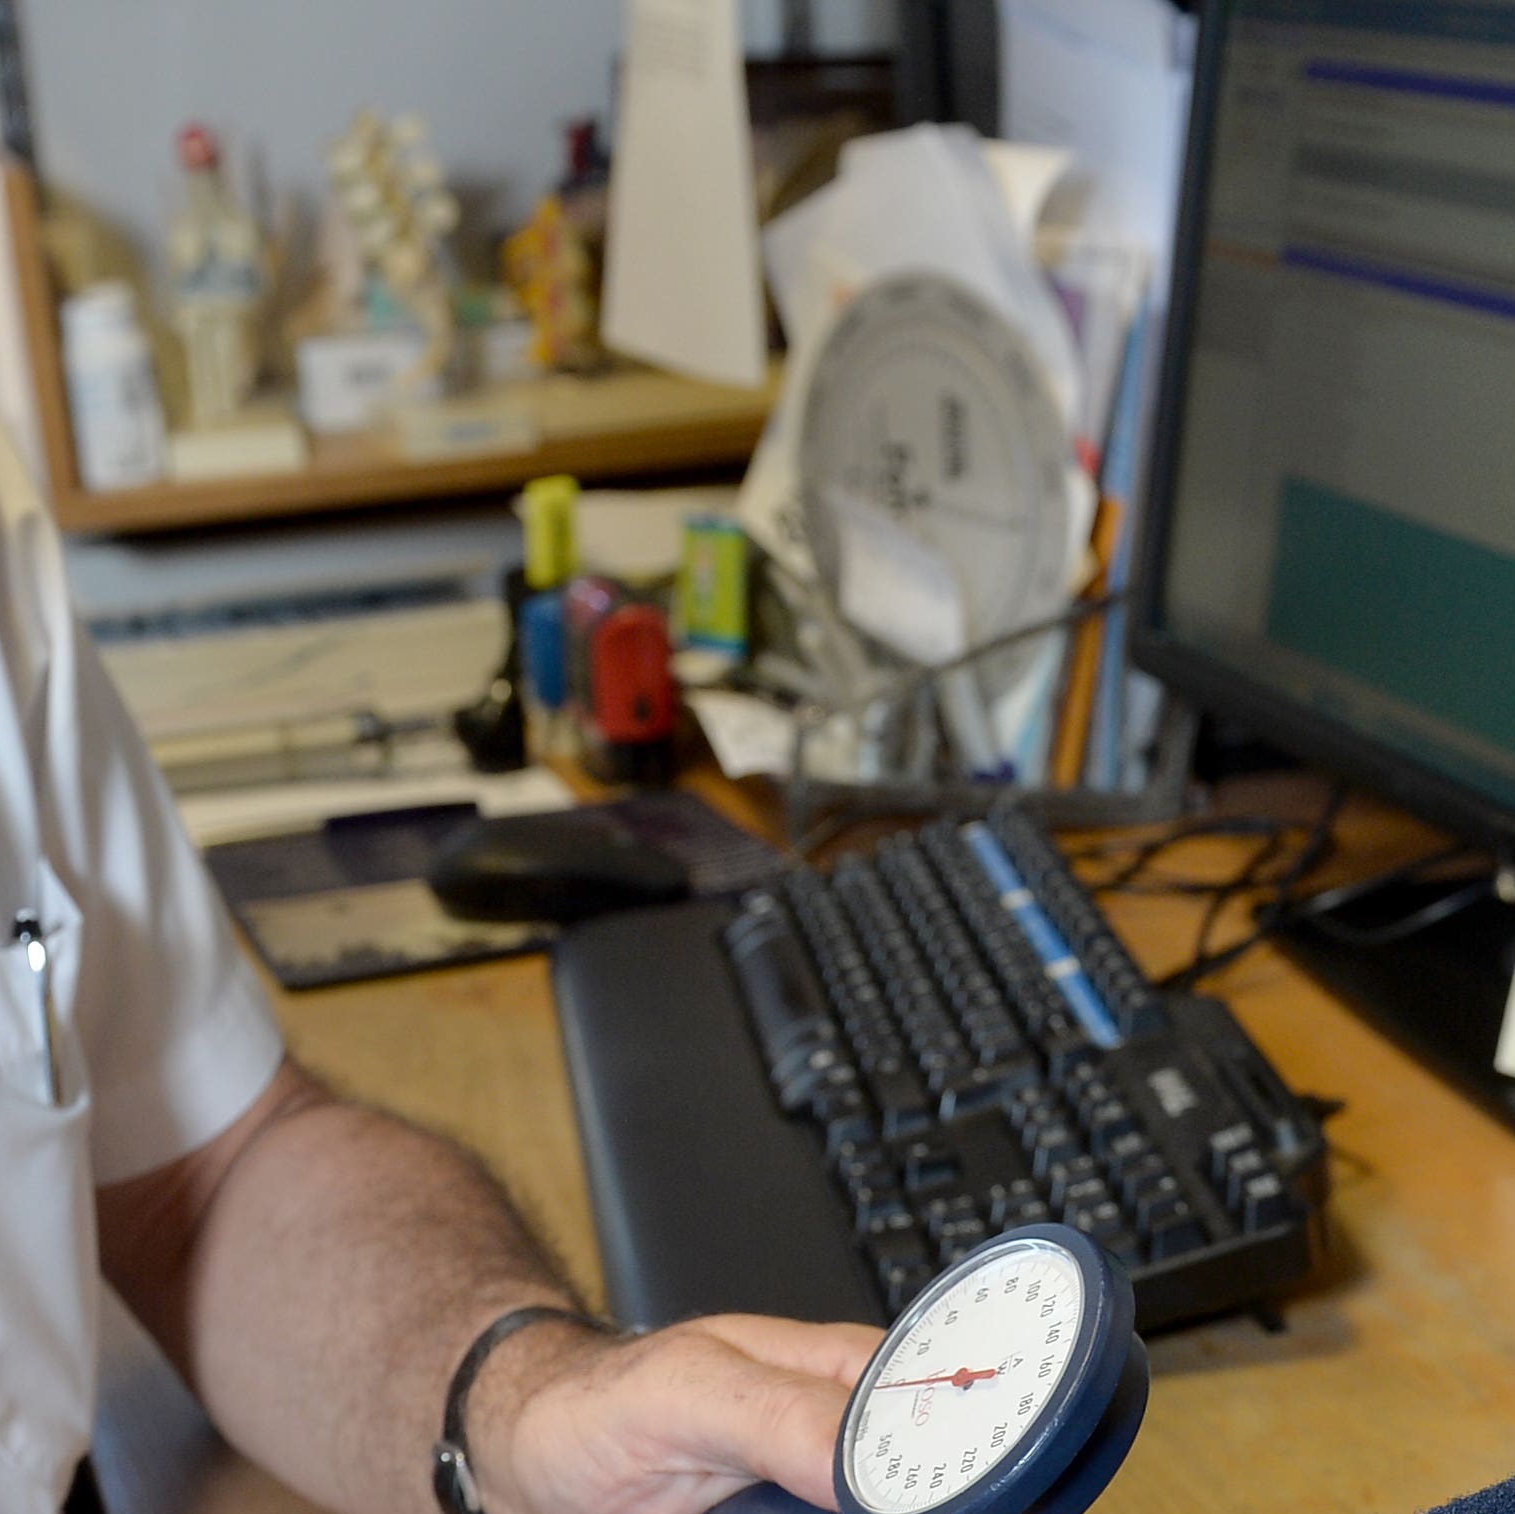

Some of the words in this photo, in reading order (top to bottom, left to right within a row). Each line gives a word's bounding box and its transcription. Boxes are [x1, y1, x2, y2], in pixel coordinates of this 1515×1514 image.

[974, 1287, 990, 1303] 60
[1004, 1276, 1019, 1294] 80
[1025, 1280, 1041, 1302] 100
[944, 1309, 959, 1325] 40
[1040, 1294, 1057, 1318] 120
[1045, 1320, 1062, 1344] 140
[917, 1338, 932, 1356] 20
[1038, 1354, 1055, 1379] 160
[1017, 1392, 1034, 1416] 180
[875, 1433, 893, 1458] 300
[990, 1422, 1008, 1448] 200
[885, 1454, 903, 1480] 280
[960, 1447, 978, 1474] 220
[904, 1464, 921, 1490] 260
[929, 1463, 947, 1489] 240
